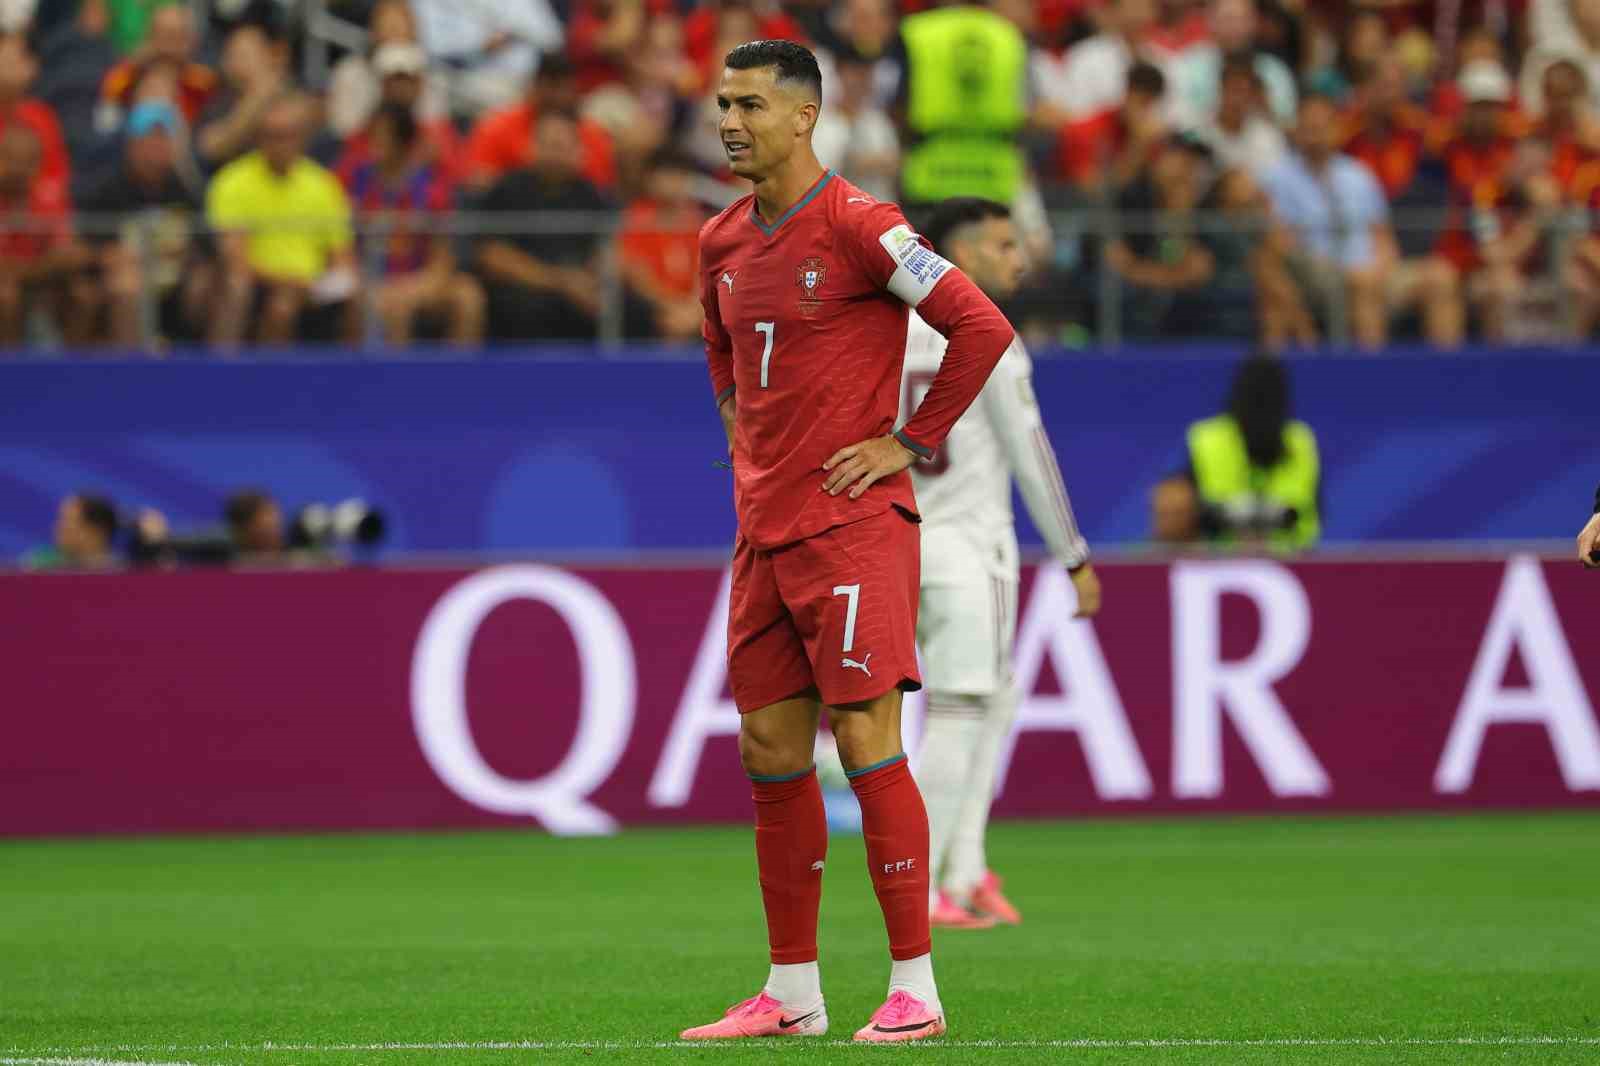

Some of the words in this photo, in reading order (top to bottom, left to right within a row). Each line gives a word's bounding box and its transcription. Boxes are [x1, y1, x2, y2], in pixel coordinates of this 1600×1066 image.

[755, 322, 774, 388] 7
[833, 584, 860, 652] 7
[409, 560, 1332, 837] QAAR
